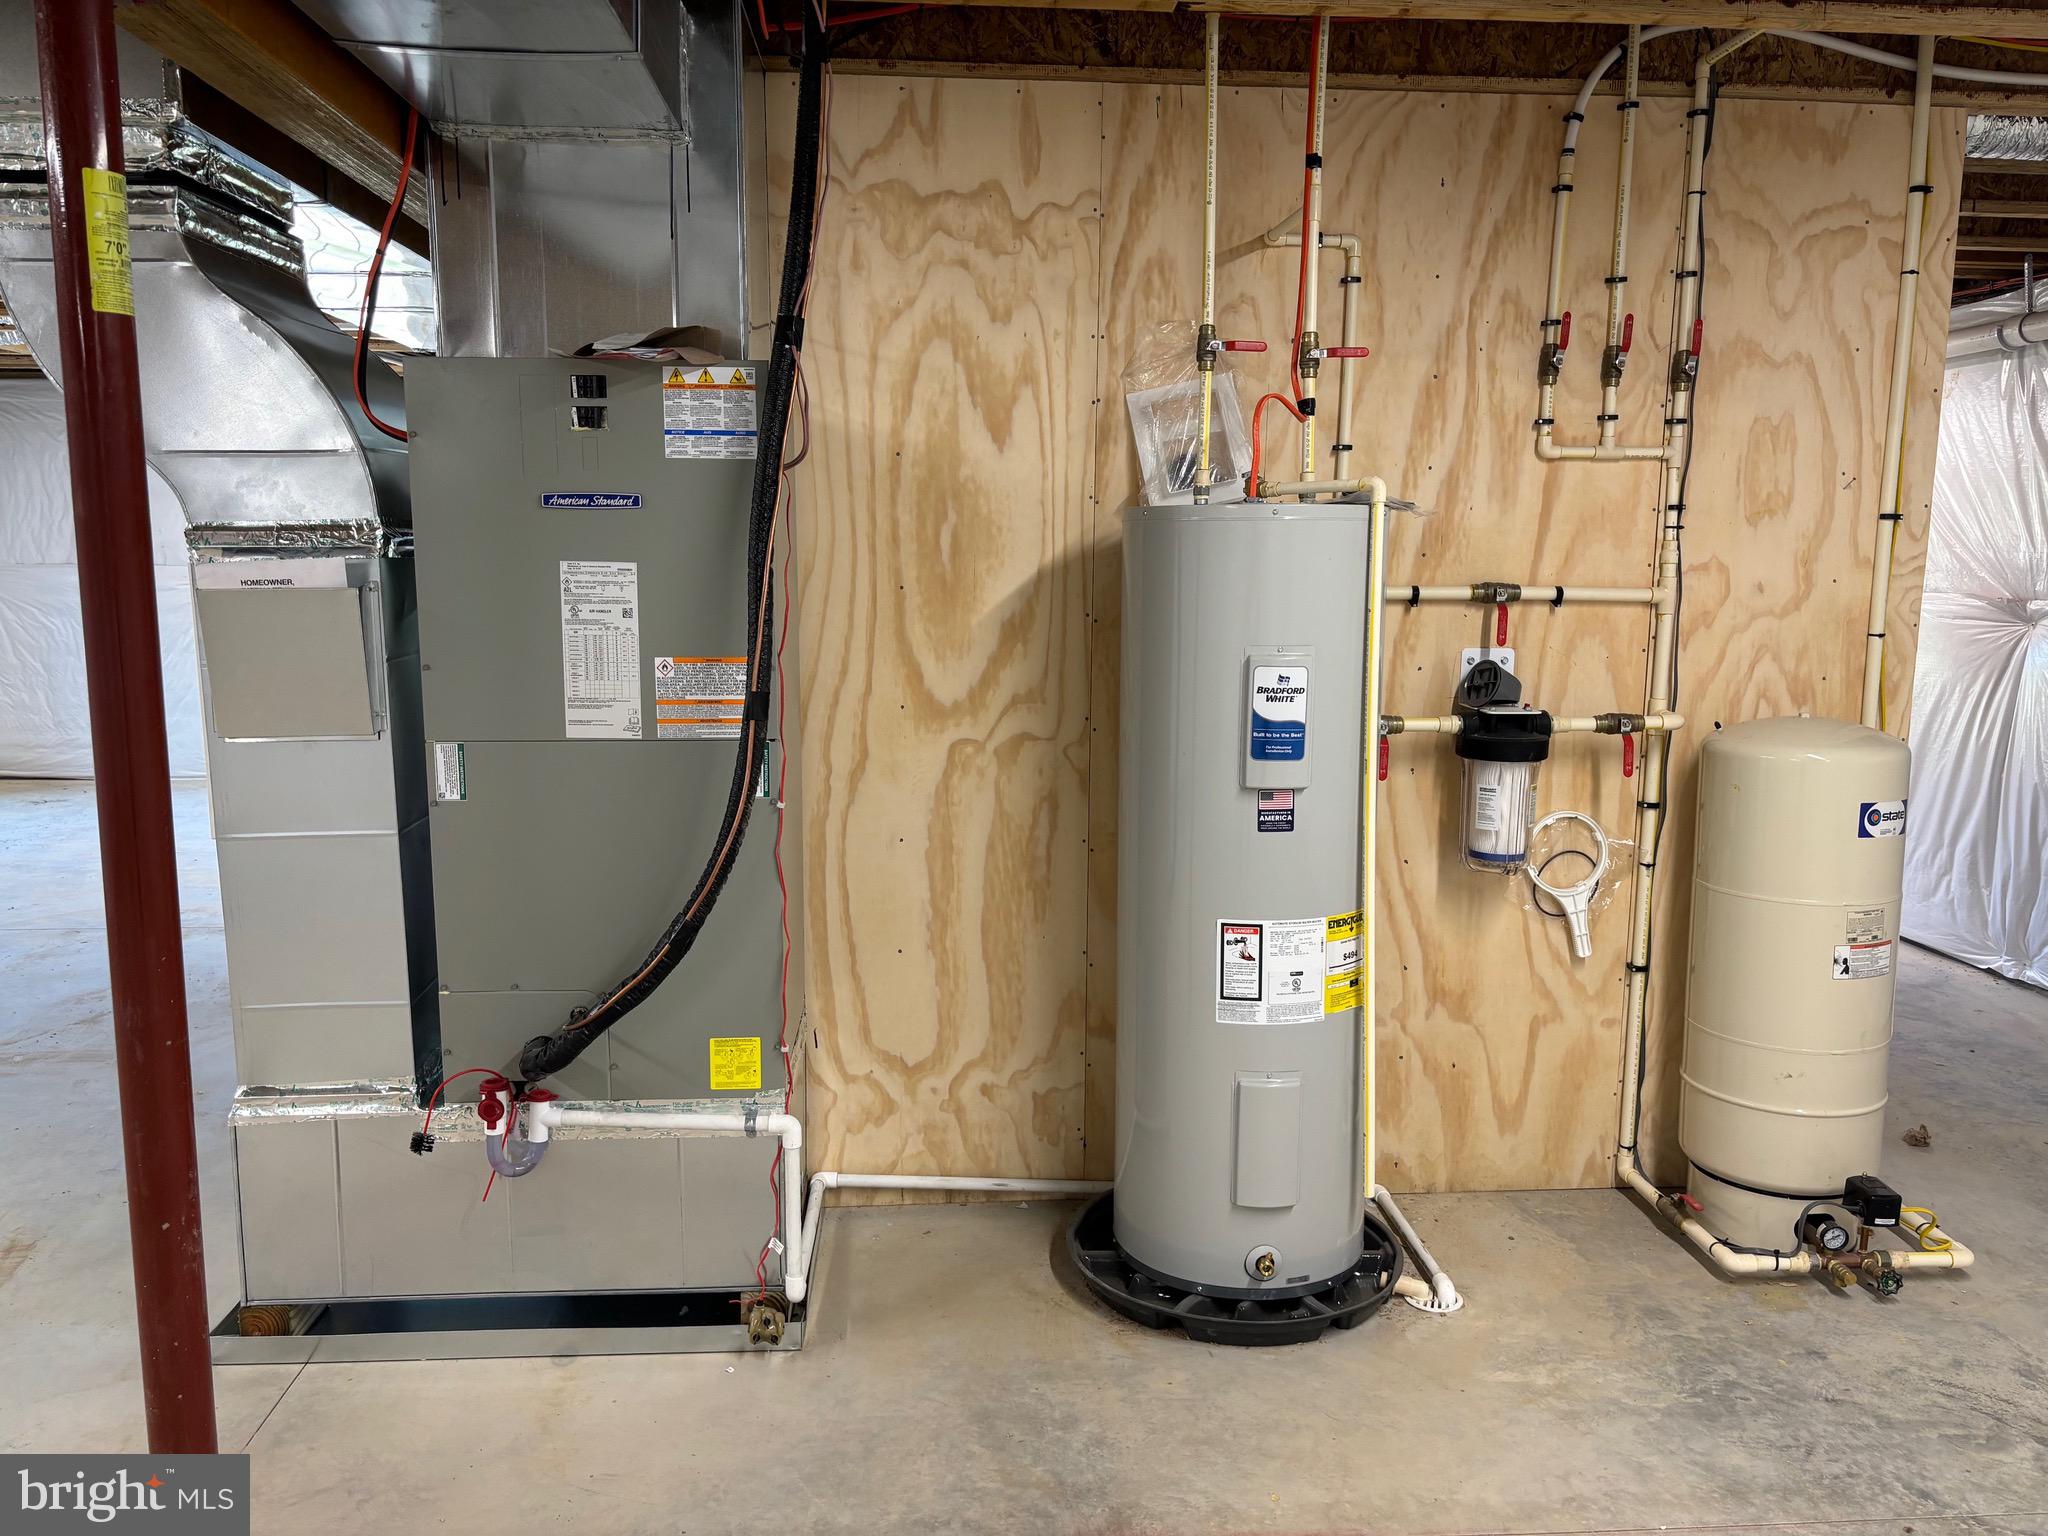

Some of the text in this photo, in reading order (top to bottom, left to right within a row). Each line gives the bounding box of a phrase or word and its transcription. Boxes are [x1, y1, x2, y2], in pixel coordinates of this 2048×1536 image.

[548, 494, 635, 506] American Standard
[240, 578, 295, 587] HOMEOWNER,
[1256, 686, 1305, 695] BRADFORD
[1265, 694, 1295, 703] WHITE
[1881, 810, 1905, 822] state
